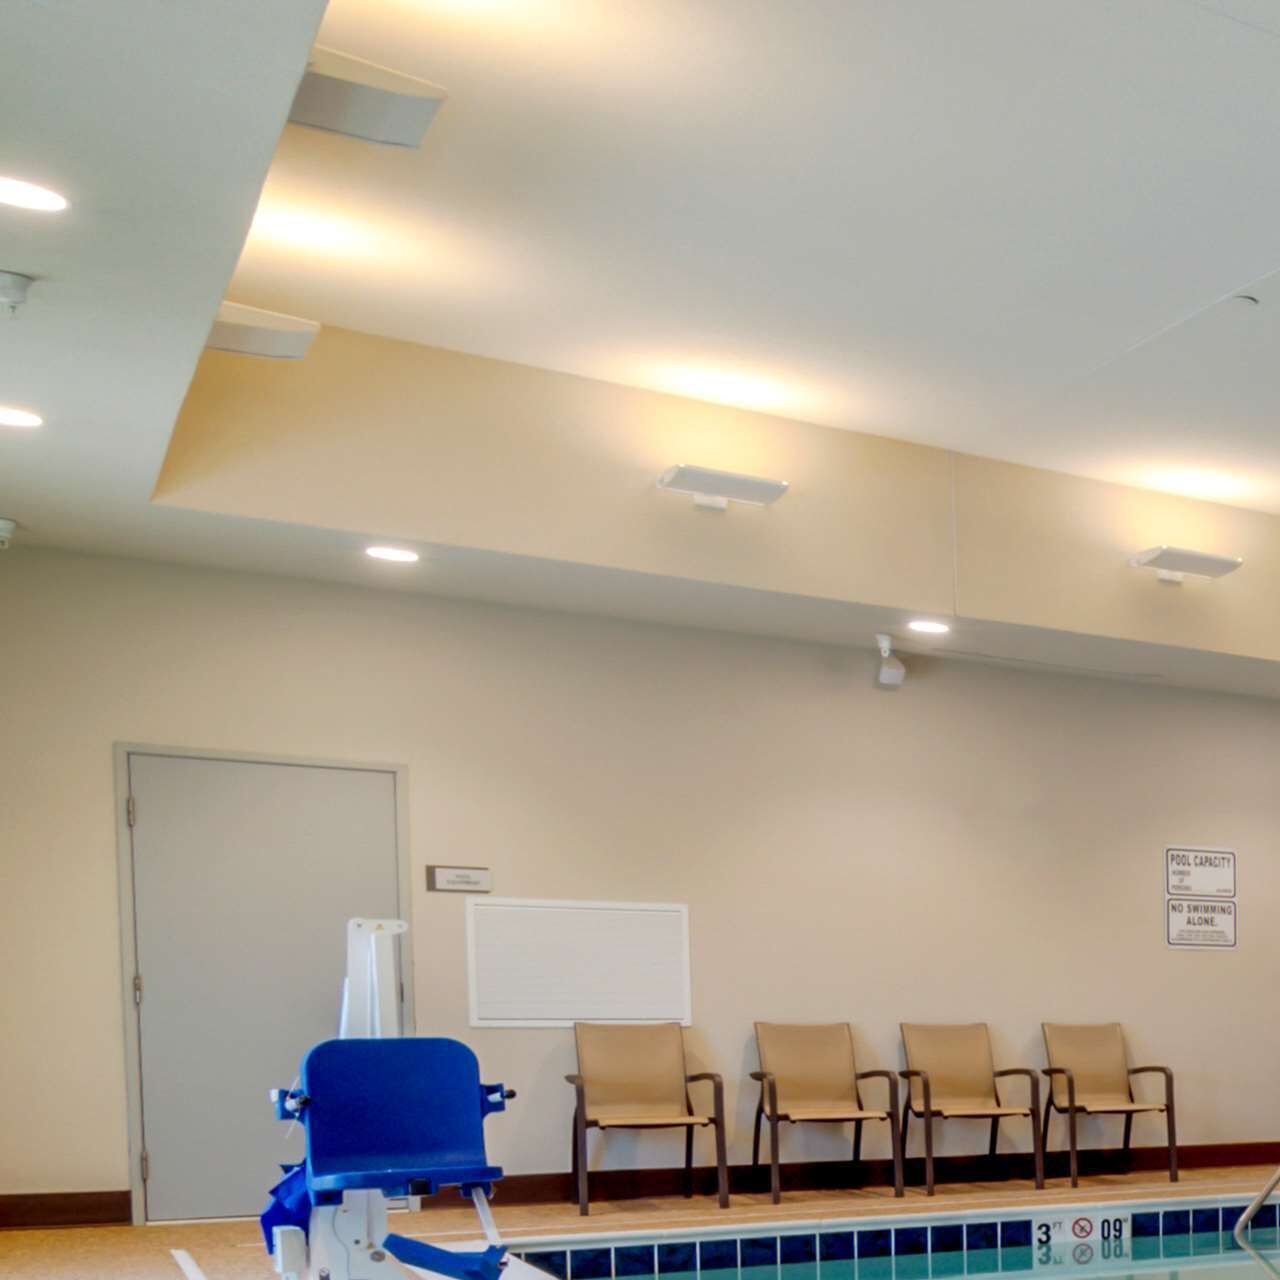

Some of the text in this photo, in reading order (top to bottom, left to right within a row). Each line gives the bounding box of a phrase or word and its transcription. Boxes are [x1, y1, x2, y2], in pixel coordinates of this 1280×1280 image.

[1170, 853, 1231, 869] POOL CAPACITY
[1170, 903, 1233, 916] NO SWIMMING
[1037, 1223, 1052, 1245] 3
